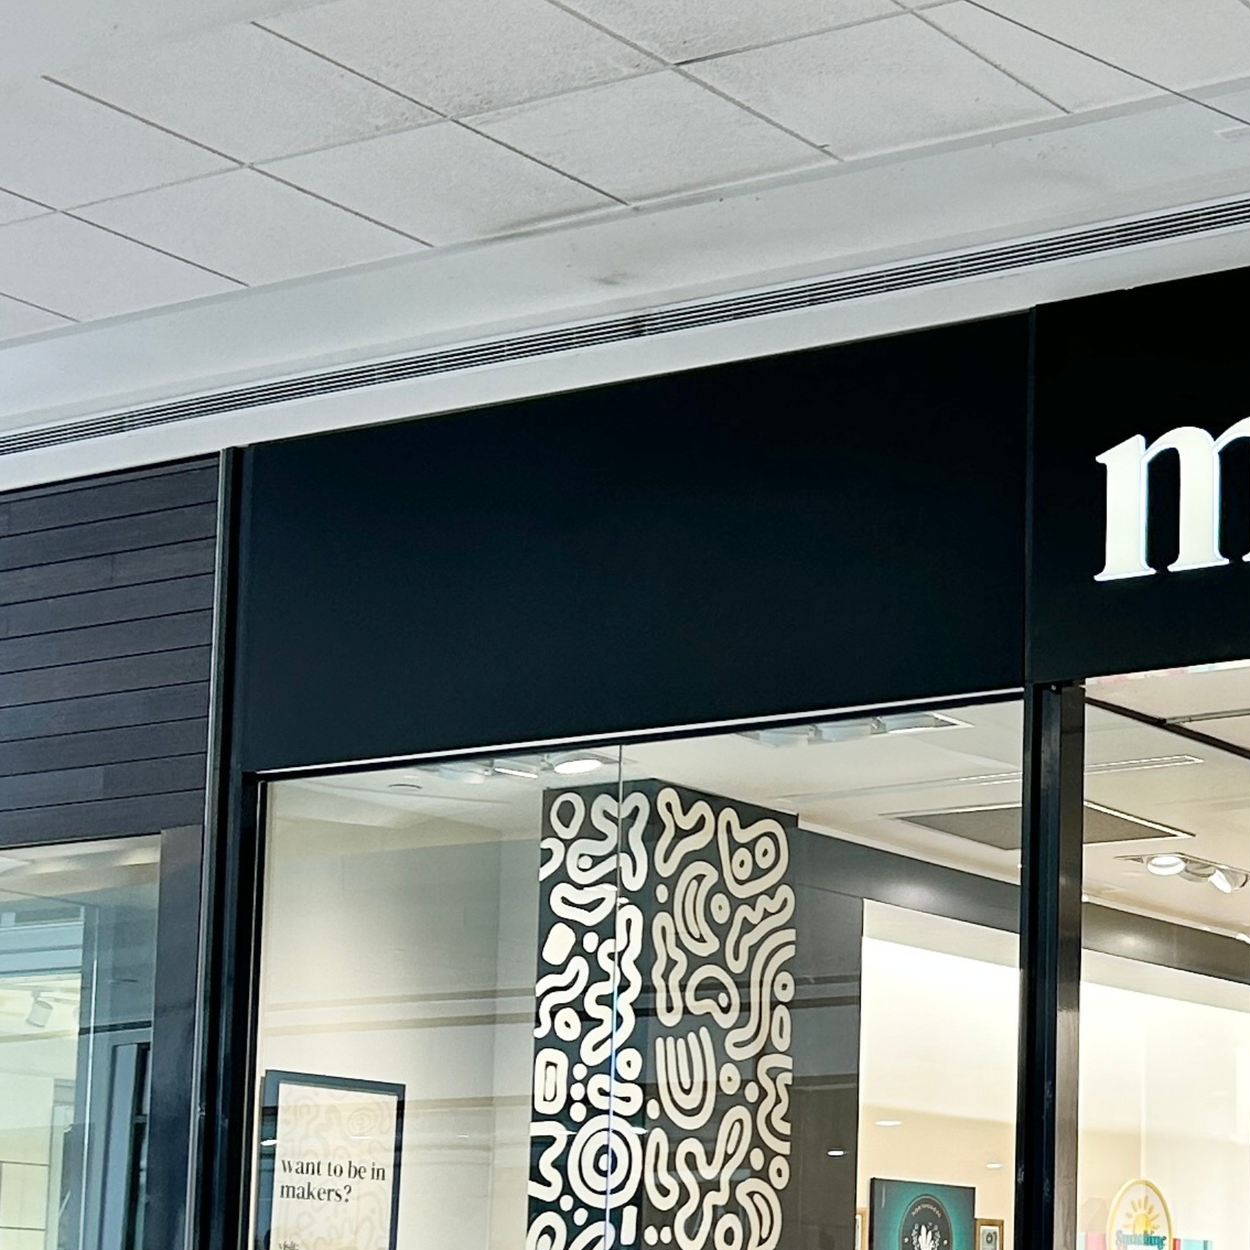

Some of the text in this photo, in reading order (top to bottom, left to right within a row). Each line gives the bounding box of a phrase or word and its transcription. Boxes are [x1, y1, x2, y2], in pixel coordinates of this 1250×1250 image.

[327, 1162, 343, 1178] to
[348, 1160, 367, 1180] be
[371, 1162, 386, 1181] in
[280, 1181, 352, 1203] makers?
